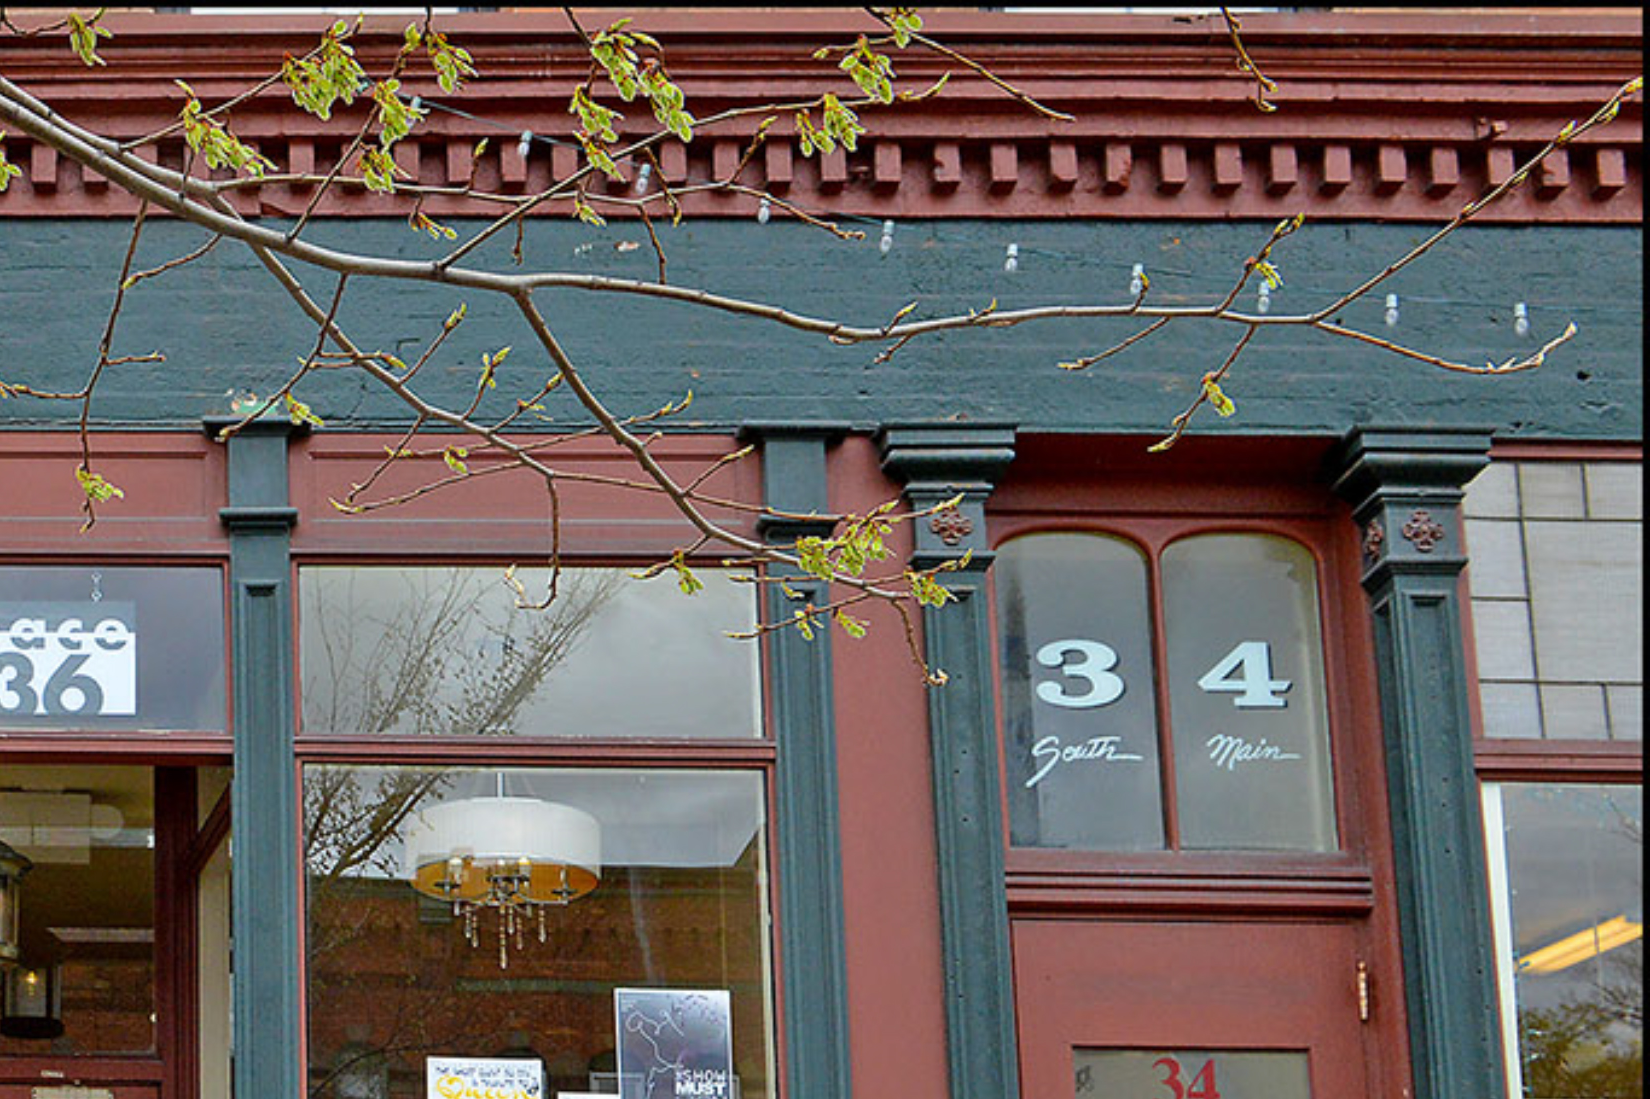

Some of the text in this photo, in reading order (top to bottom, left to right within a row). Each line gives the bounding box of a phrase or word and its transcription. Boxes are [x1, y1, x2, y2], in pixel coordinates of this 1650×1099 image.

[1026, 733, 1301, 788] South Main
[683, 1069, 726, 1082] SHOW
[676, 1082, 726, 1096] MUST
